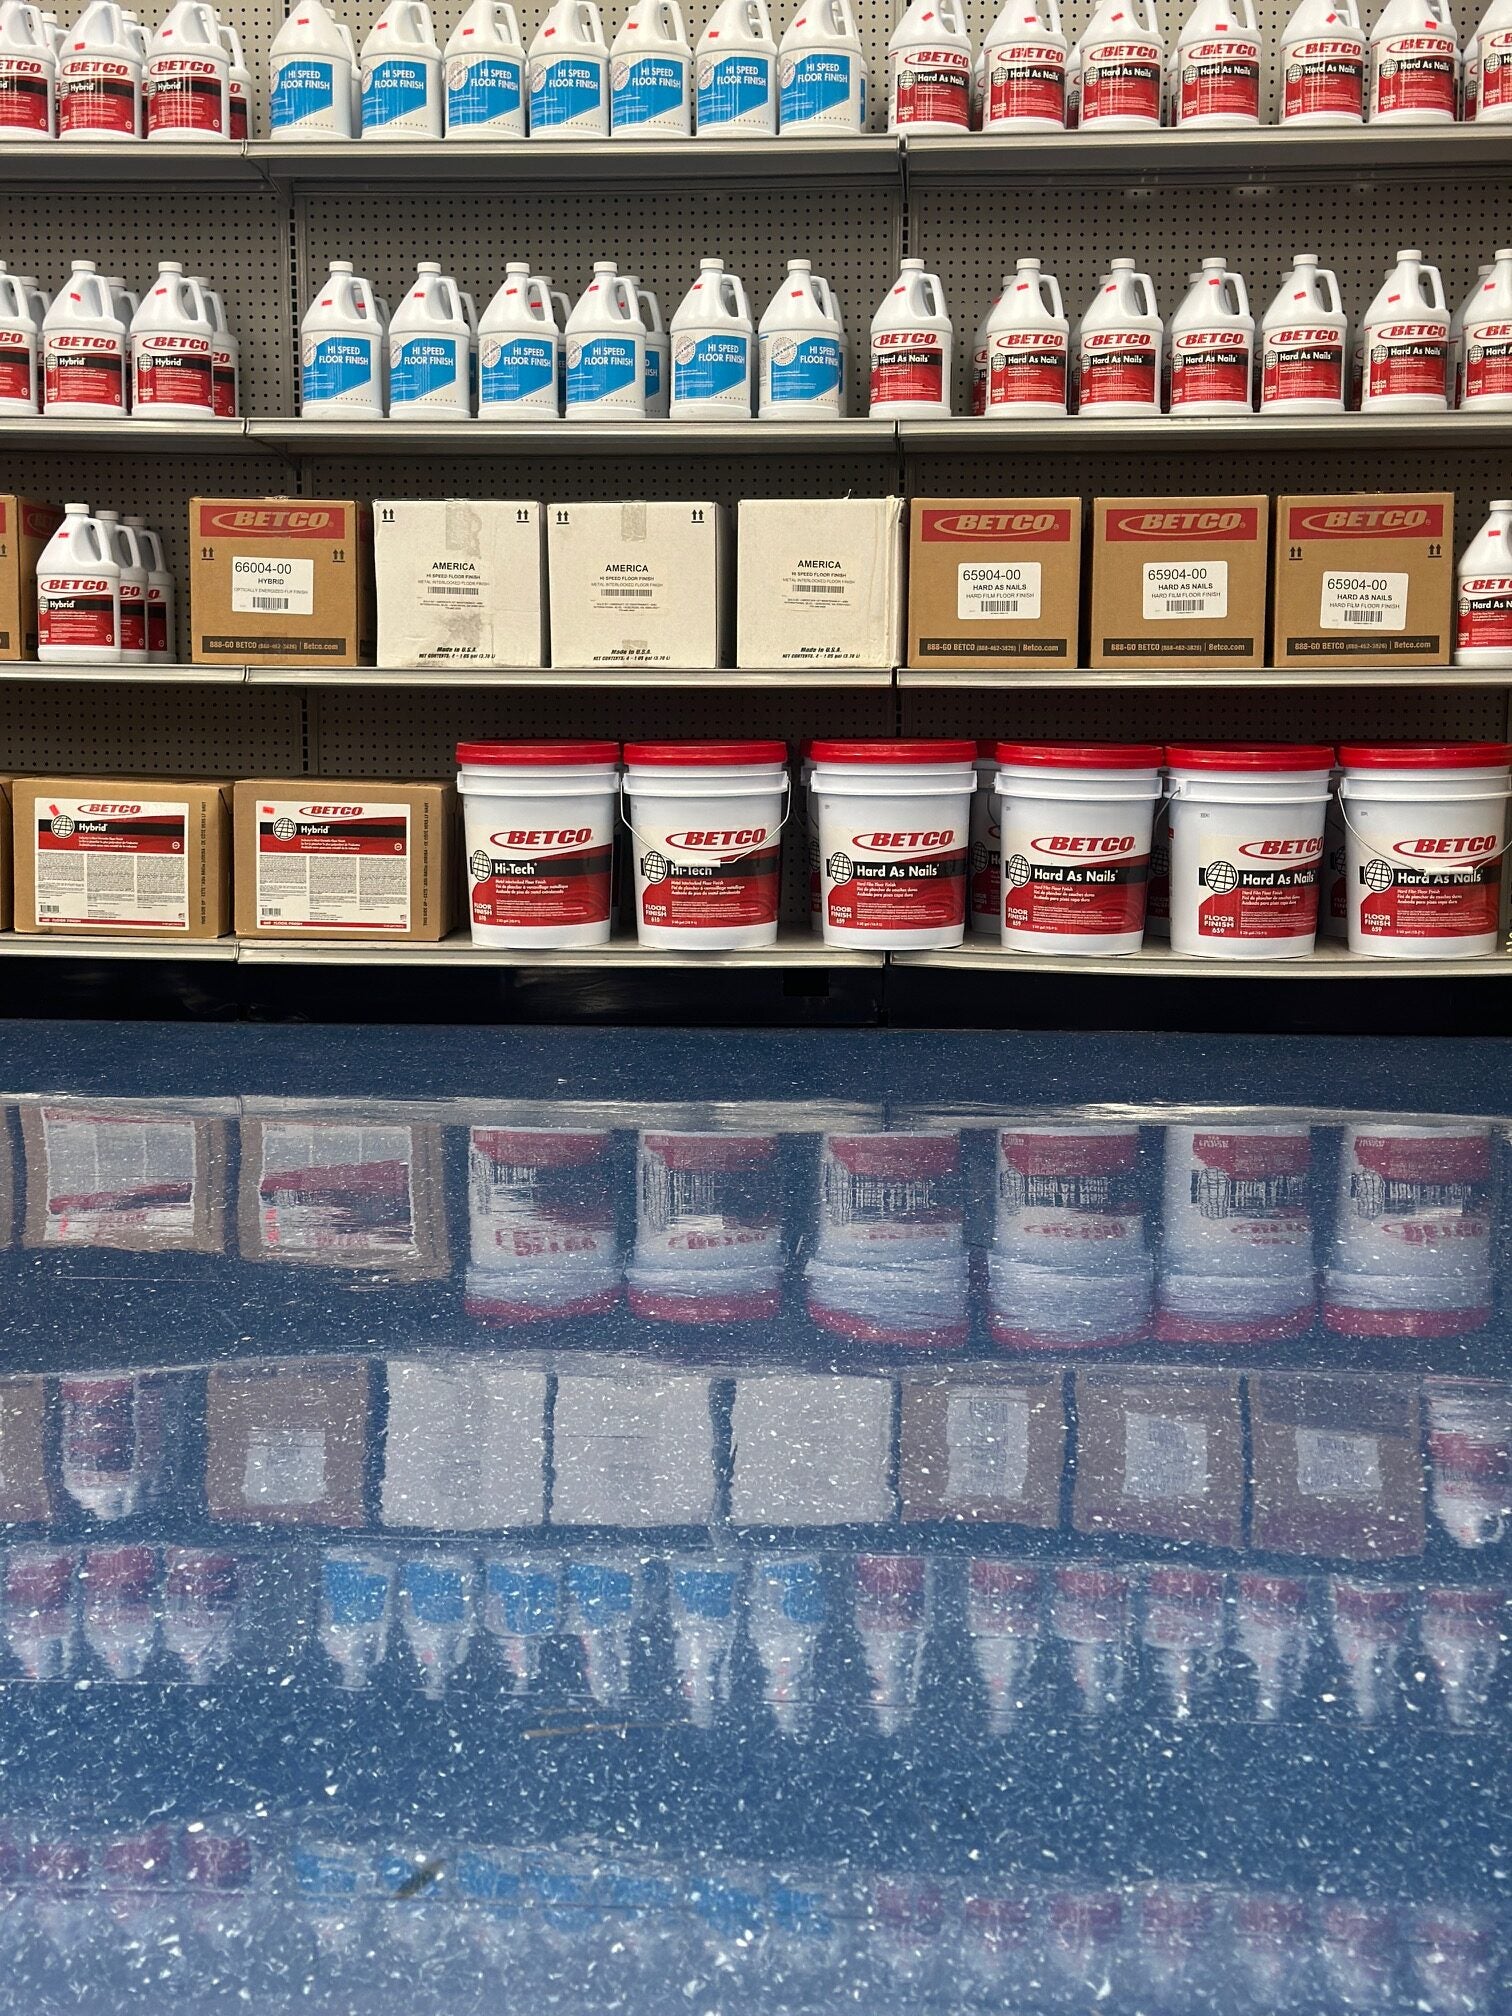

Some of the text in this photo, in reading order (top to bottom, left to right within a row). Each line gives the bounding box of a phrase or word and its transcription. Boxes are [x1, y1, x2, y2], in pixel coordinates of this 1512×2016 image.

[1199, 45, 1258, 57] BETCO
[1305, 43, 1361, 55] BETCO
[1401, 39, 1454, 53] BETCO
[1010, 48, 1063, 63] BETCO
[1100, 46, 1157, 59] BETCO
[917, 52, 969, 67] BETCO
[70, 61, 128, 75] BETCO
[157, 60, 215, 75] BETCO
[806, 63, 839, 72] HI SPEED
[1305, 64, 1355, 74] Hard As Nails
[288, 70, 321, 79] HI SPEED
[798, 74, 848, 83] FLOOR FINISH
[918, 74, 964, 86] Hard As Nails
[71, 82, 94, 92] Hybrid
[157, 81, 181, 92] Hybrid
[281, 80, 330, 90] FLOOR FINISH
[1279, 330, 1338, 341] BETCO
[1390, 325, 1446, 337] BETCO
[58, 337, 116, 350] BETCO
[154, 337, 209, 351] BETCO
[879, 333, 937, 345] BETCO
[1008, 334, 1063, 346] BETCO
[1091, 334, 1151, 345] BETCO
[1185, 334, 1244, 345] BETCO
[328, 346, 360, 355] HI SPEED
[593, 348, 625, 357] HI SPEED
[1391, 347, 1440, 356] Hard As Nails
[59, 357, 84, 367] Hybrid
[155, 357, 183, 367] Hybrid
[319, 355, 368, 366] FLOOR FINISH
[584, 356, 633, 366] FLOOR FINISH
[880, 354, 928, 363] Hard As Nails
[1008, 356, 1057, 365] Hard As Nails
[1093, 355, 1142, 365] Hard As Nails
[1186, 355, 1236, 364] Hard As Nails
[1280, 352, 1331, 361] Hard As Nails
[234, 511, 330, 527] BETCO
[956, 515, 1055, 531] BETCO
[1141, 513, 1241, 529] BETCO
[1325, 510, 1427, 528] BETCO
[235, 562, 292, 574] 66004-00
[432, 562, 475, 571] AMERICA
[606, 564, 648, 572] AMERICA
[798, 560, 841, 569] AMERICA
[963, 570, 1021, 581] 65904-00
[1149, 568, 1207, 580] 65904-00
[50, 580, 107, 591] BETCO
[1328, 579, 1387, 590] 65904-00
[50, 601, 74, 609] Hybrid
[1493, 601, 1503, 609] As
[1394, 641, 1431, 649] Betco.com
[89, 804, 141, 814] BETCO
[311, 806, 363, 815] BETCO
[79, 823, 106, 832] Hybrid
[301, 825, 328, 834] Hybrid
[507, 829, 592, 844] BETCO
[685, 829, 766, 845] BETCO
[871, 830, 954, 846] BETCO
[1049, 837, 1135, 851] BETCO
[1260, 836, 1324, 854] BETCO
[1415, 835, 1496, 852] BETCO
[495, 863, 535, 874] Hi-Tech
[671, 867, 712, 875] Hi-Tech
[857, 866, 937, 877] Hard As Nails
[1035, 869, 1115, 881] Hard As Nails
[1243, 872, 1314, 885] Hard As Nails
[1398, 873, 1481, 883] Hard As Nails
